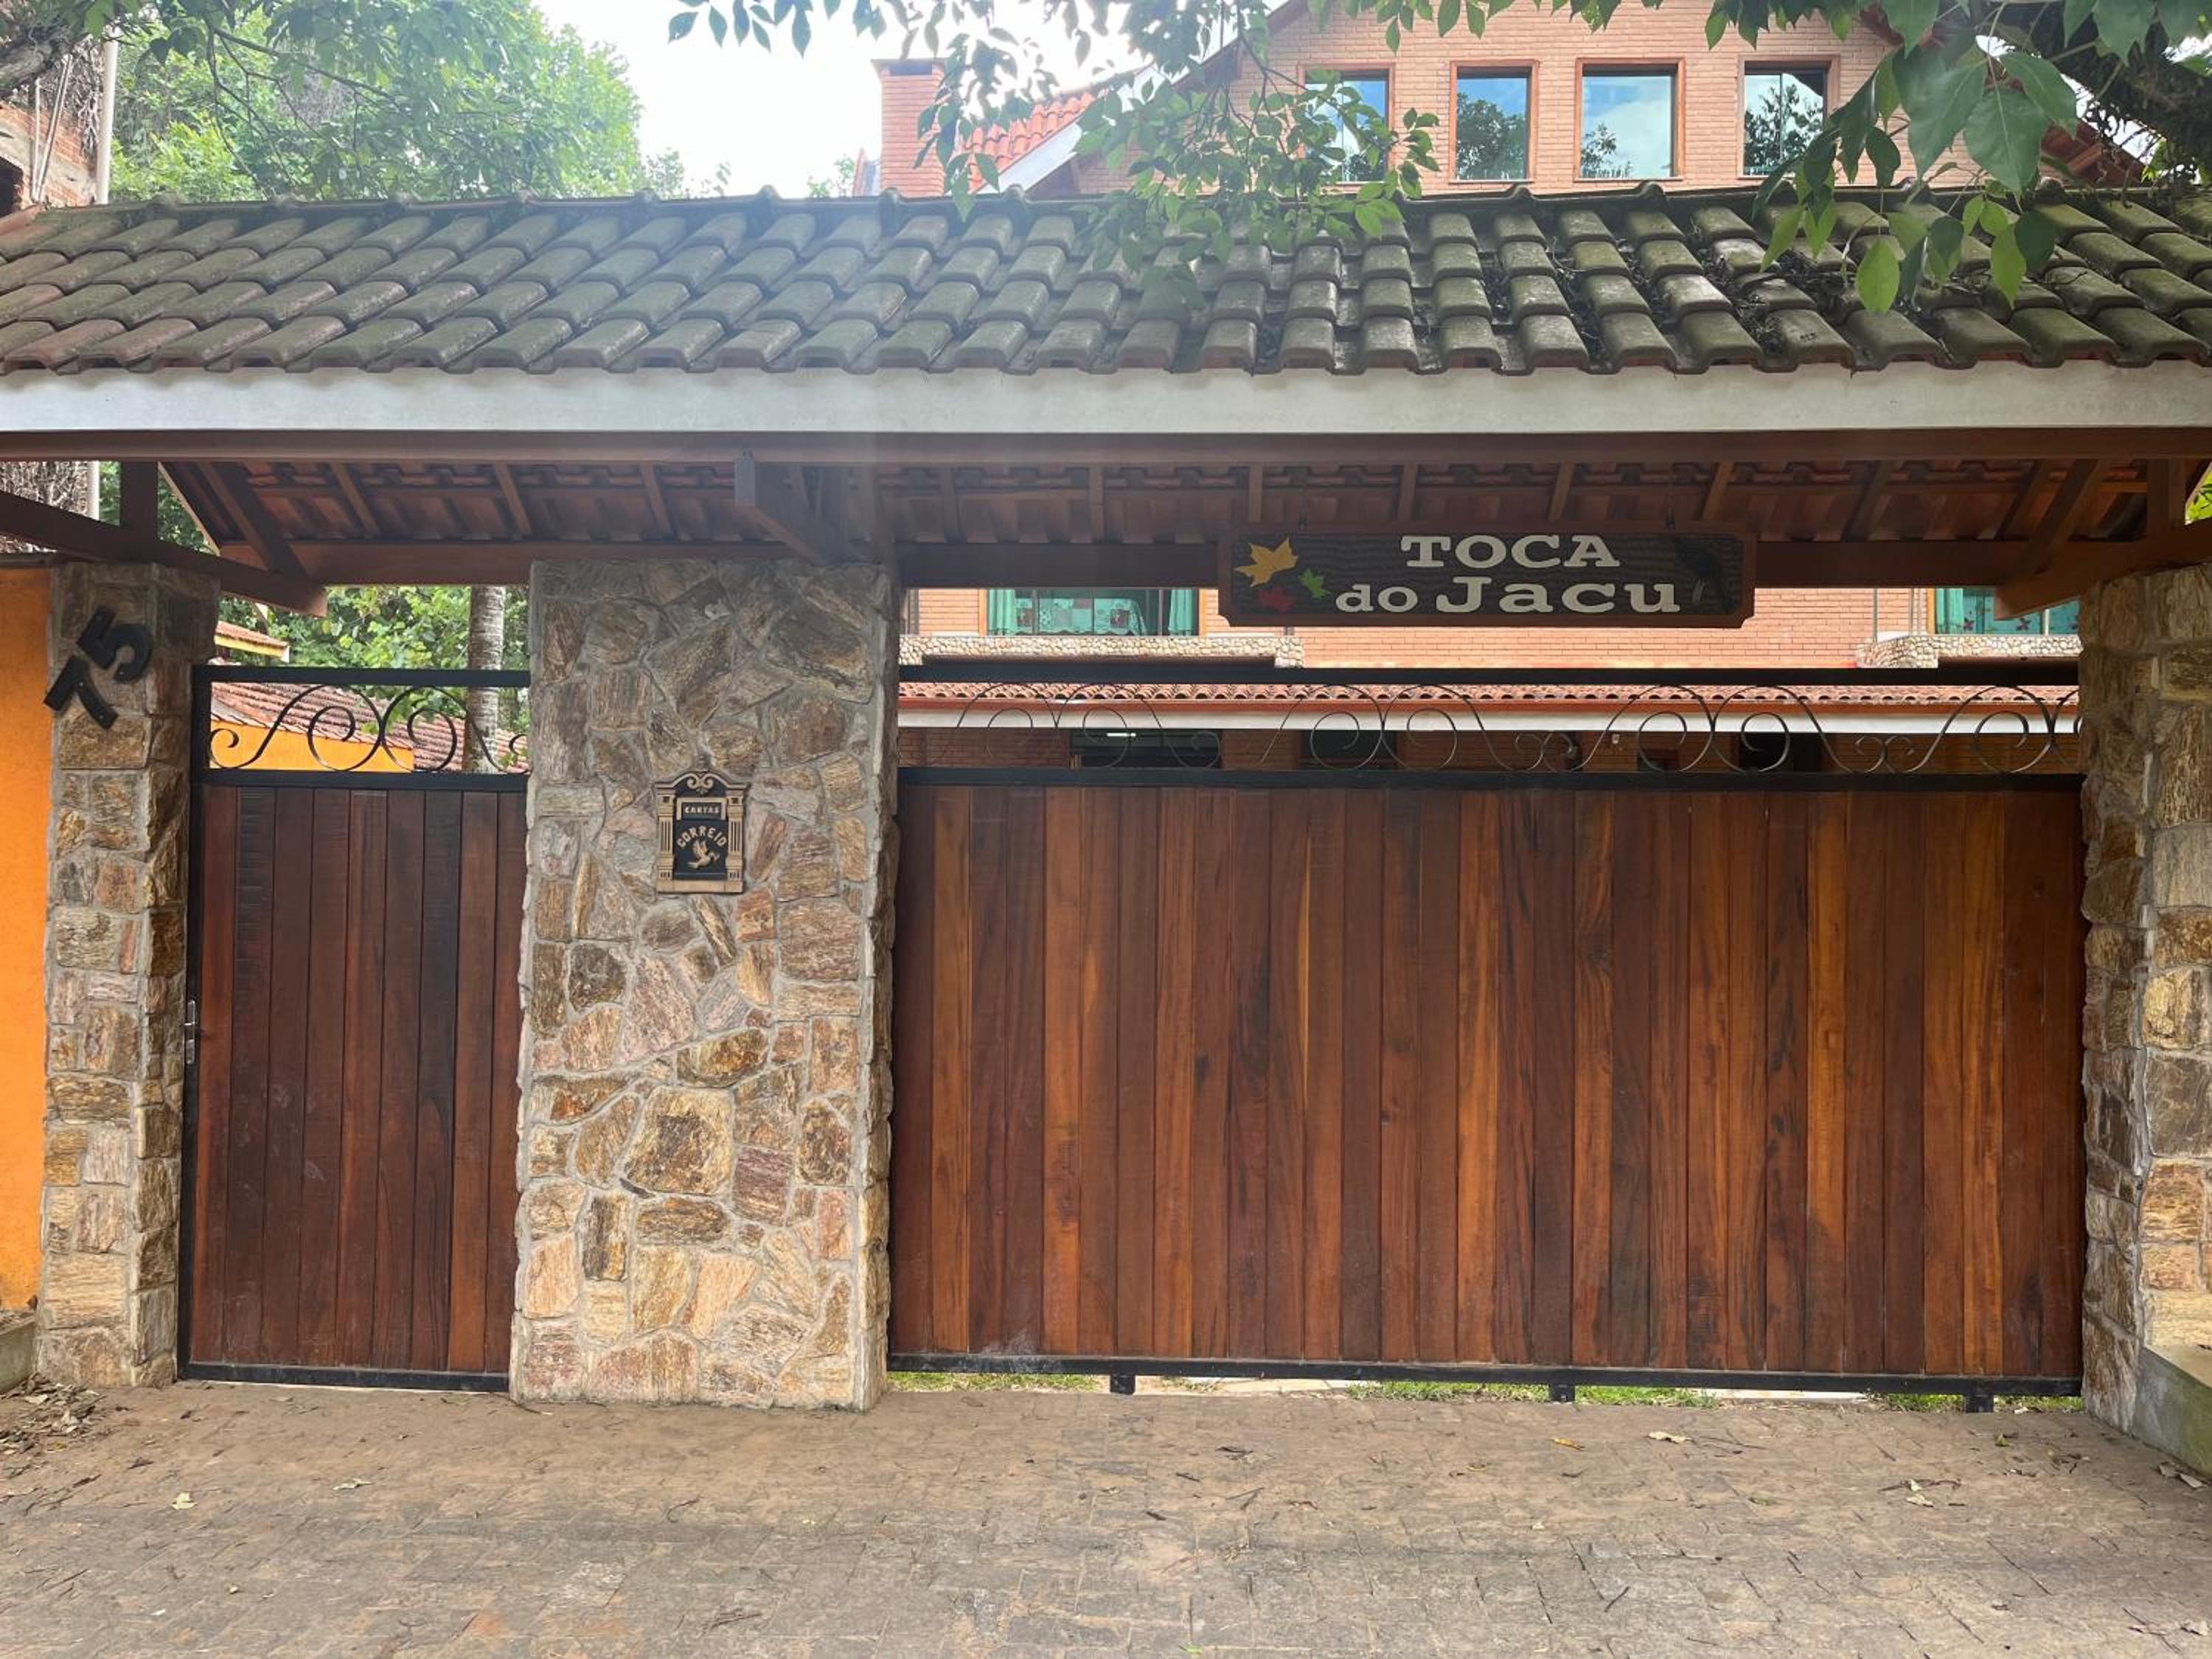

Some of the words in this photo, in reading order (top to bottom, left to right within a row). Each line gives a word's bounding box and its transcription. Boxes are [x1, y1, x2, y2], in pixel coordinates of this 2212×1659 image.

[1401, 535, 1620, 568] TOCA
[1335, 584, 1418, 612] do
[1436, 576, 1680, 613] Jacu
[43, 606, 153, 729] 75
[676, 826, 727, 848] CORREIO
